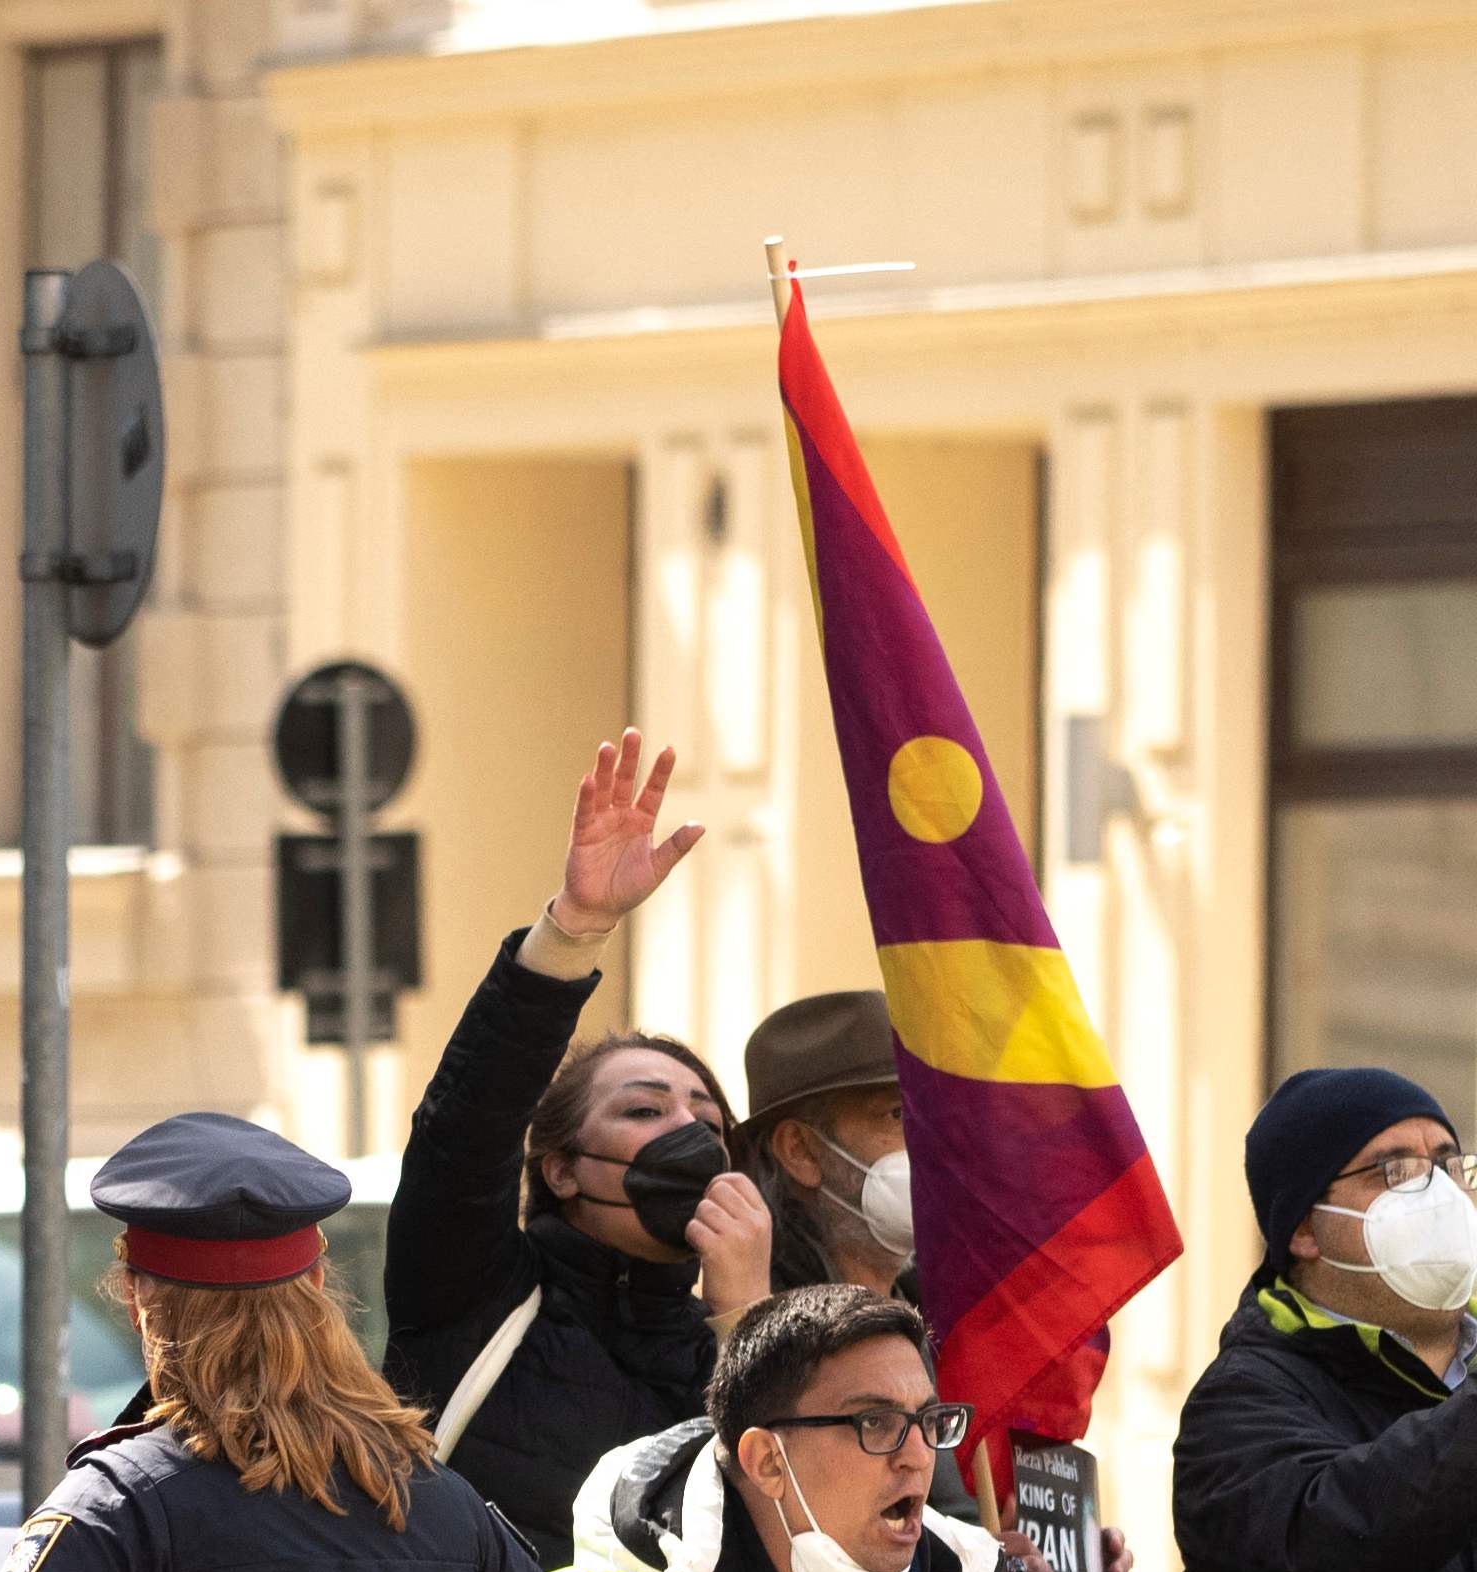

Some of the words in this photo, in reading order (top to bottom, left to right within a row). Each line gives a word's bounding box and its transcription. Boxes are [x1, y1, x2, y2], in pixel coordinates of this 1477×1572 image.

[1015, 1445, 1042, 1471] Reza
[1043, 1452, 1078, 1482] Pahlavi
[1019, 1483, 1055, 1511] KING
[1062, 1492, 1077, 1516] OF
